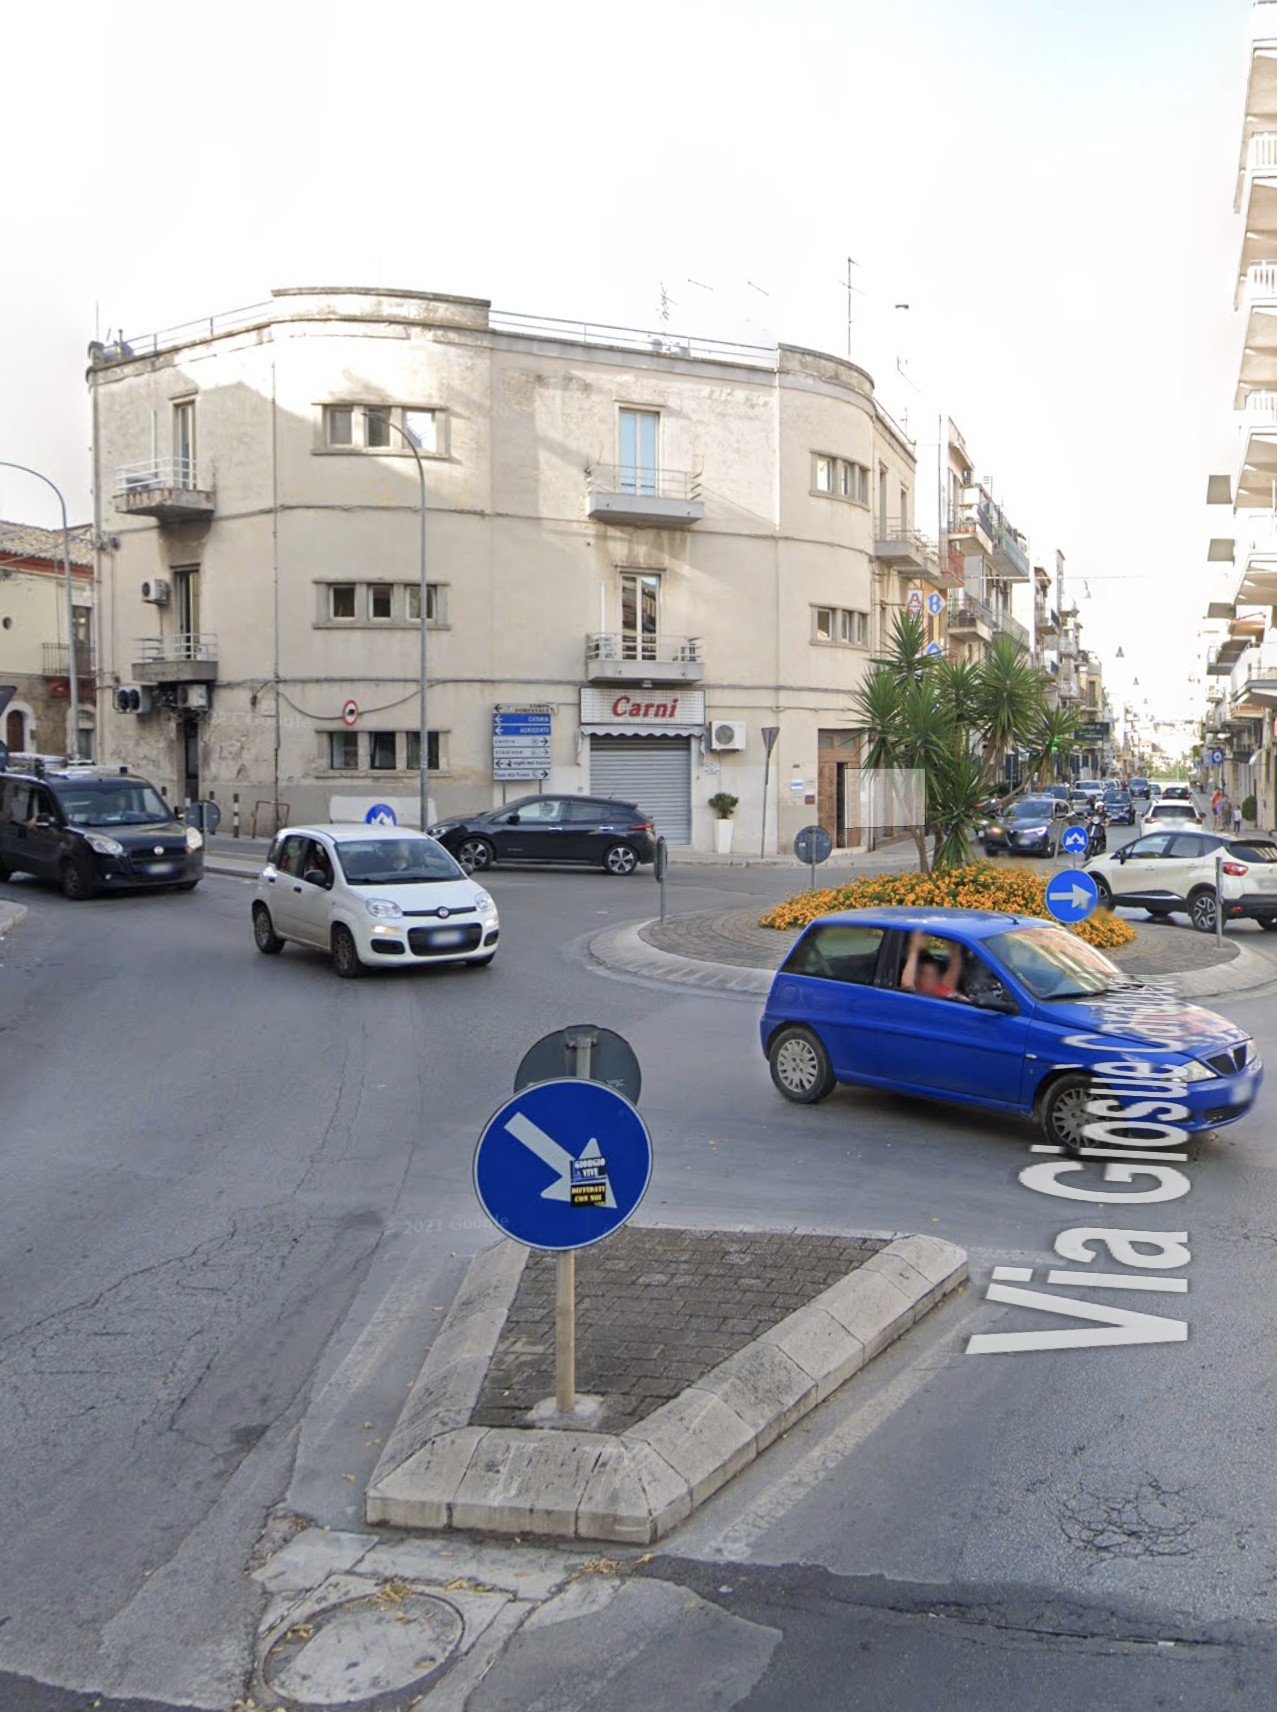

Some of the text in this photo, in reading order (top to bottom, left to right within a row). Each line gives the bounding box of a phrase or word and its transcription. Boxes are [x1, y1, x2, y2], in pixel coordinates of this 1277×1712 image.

[612, 695, 679, 718] Carni
[574, 1157, 606, 1168] GIORGIO
[582, 1168, 598, 1177] VIVE
[571, 1185, 606, 1195] DIFFIDATI
[574, 1195, 588, 1203] CON
